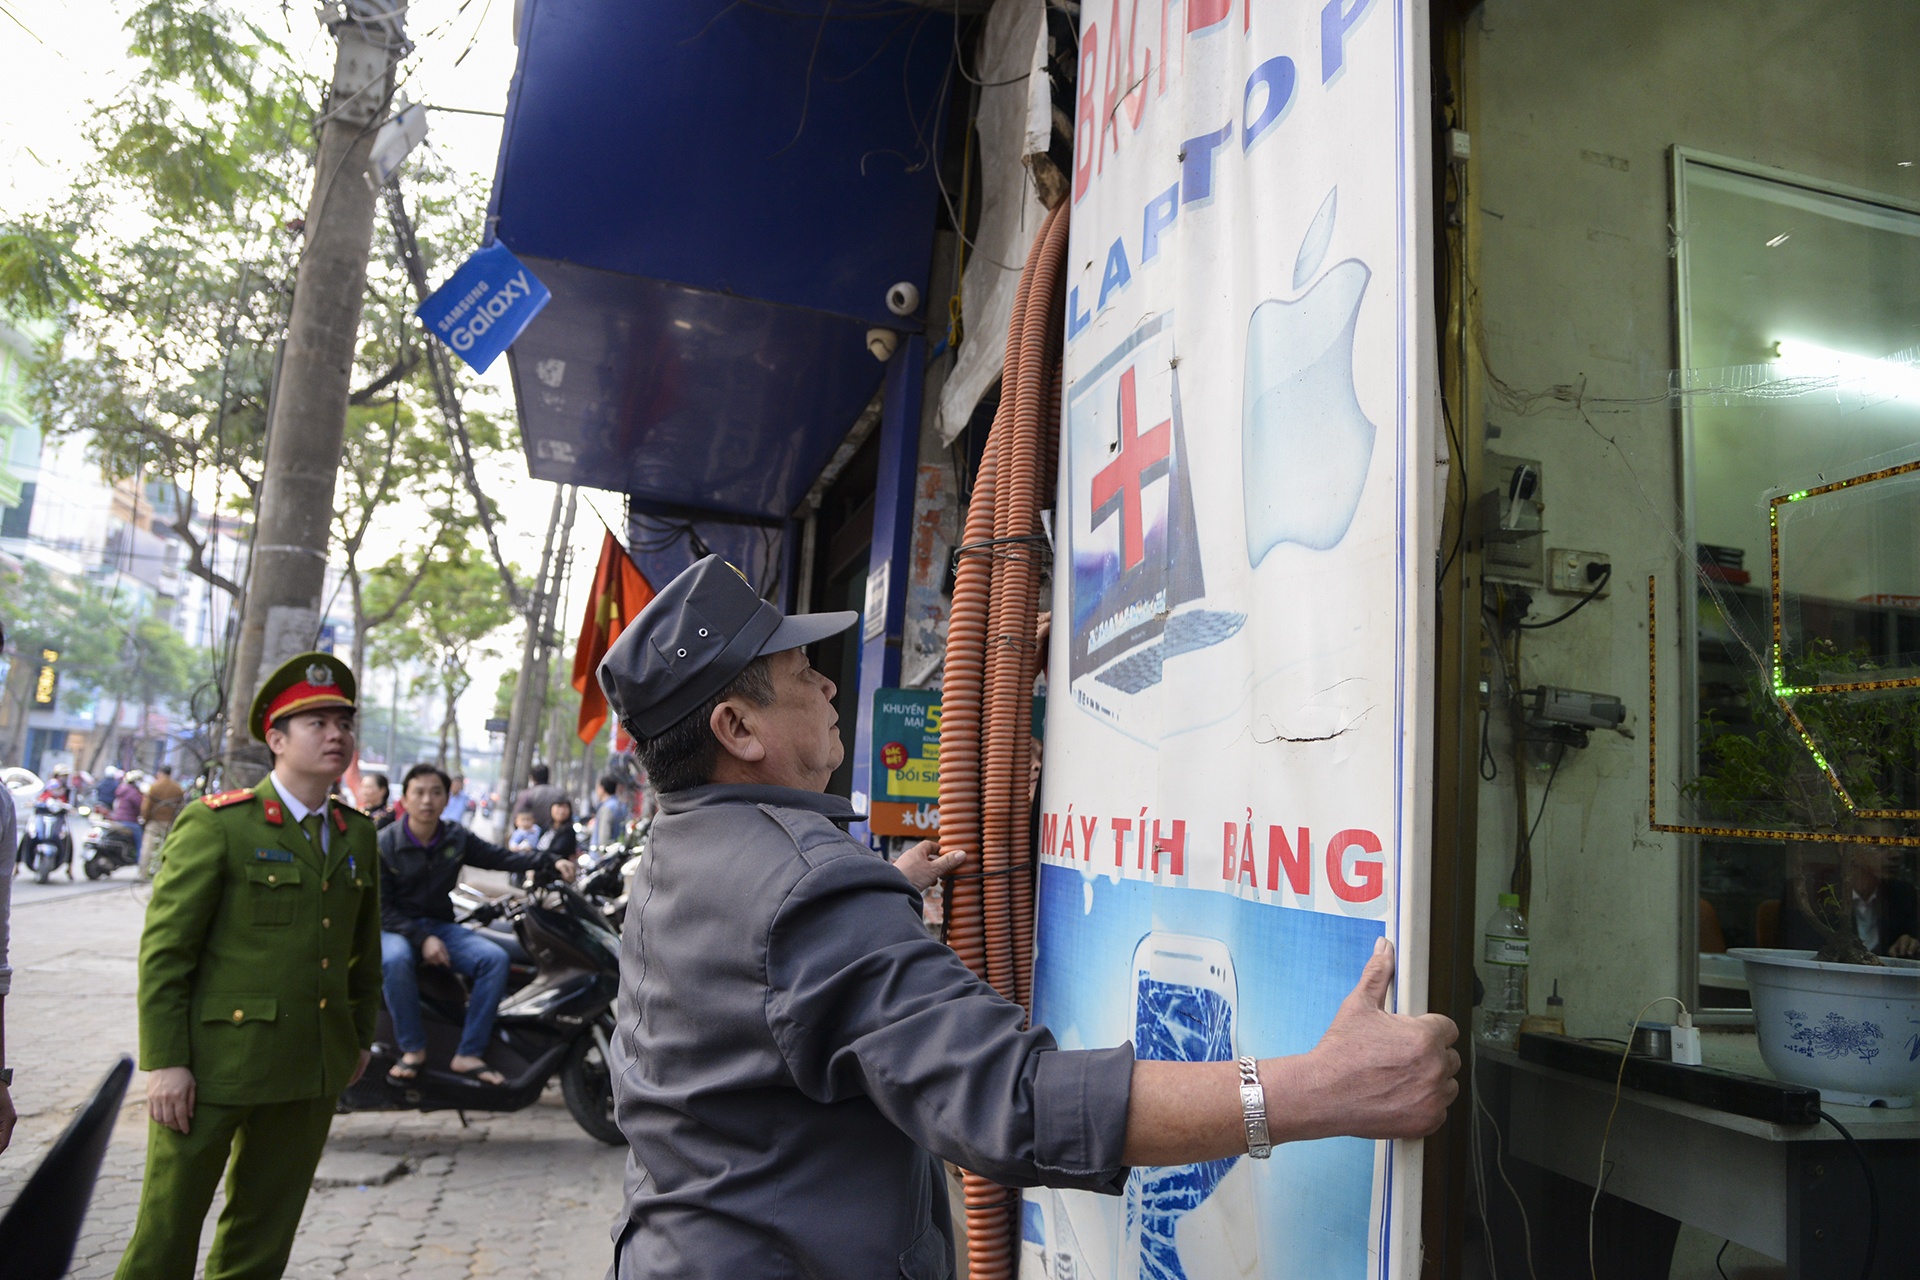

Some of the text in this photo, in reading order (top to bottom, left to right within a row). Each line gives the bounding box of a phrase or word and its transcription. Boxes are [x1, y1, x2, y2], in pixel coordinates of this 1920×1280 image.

[1067, 0, 1372, 343] LAPTOP
[437, 280, 490, 333] SAMSUNG
[450, 269, 531, 351] Galaxy
[1041, 804, 1097, 861] MÁY
[1222, 807, 1383, 903] BẢNG
